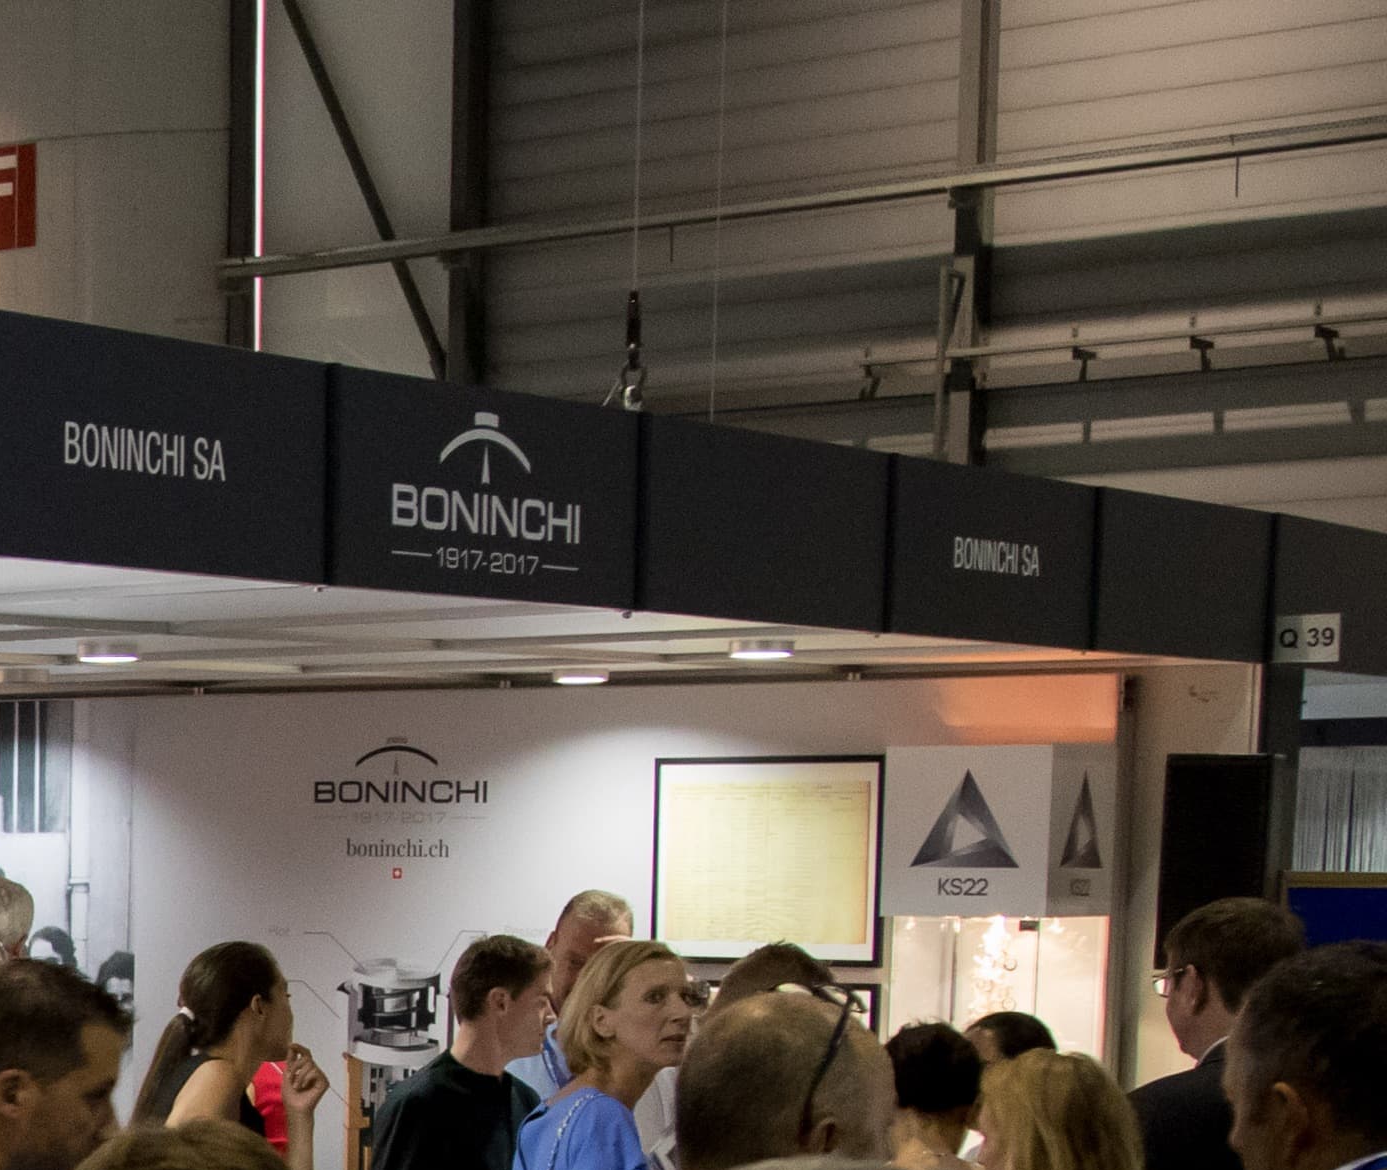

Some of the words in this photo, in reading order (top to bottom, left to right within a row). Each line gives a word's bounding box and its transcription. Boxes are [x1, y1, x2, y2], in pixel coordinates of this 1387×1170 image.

[64, 421, 185, 477] BONINCHI
[193, 437, 226, 482] SA
[392, 483, 581, 544] BONINCHI
[436, 547, 539, 575] 1917-2017
[954, 536, 1019, 574] BONINCHI
[1022, 544, 1039, 577] SA
[1280, 629, 1298, 649] Q
[1307, 627, 1335, 647] 39
[315, 781, 488, 803] BONINCHI
[347, 838, 450, 858] boninchi.ch
[938, 877, 989, 896] KS22
